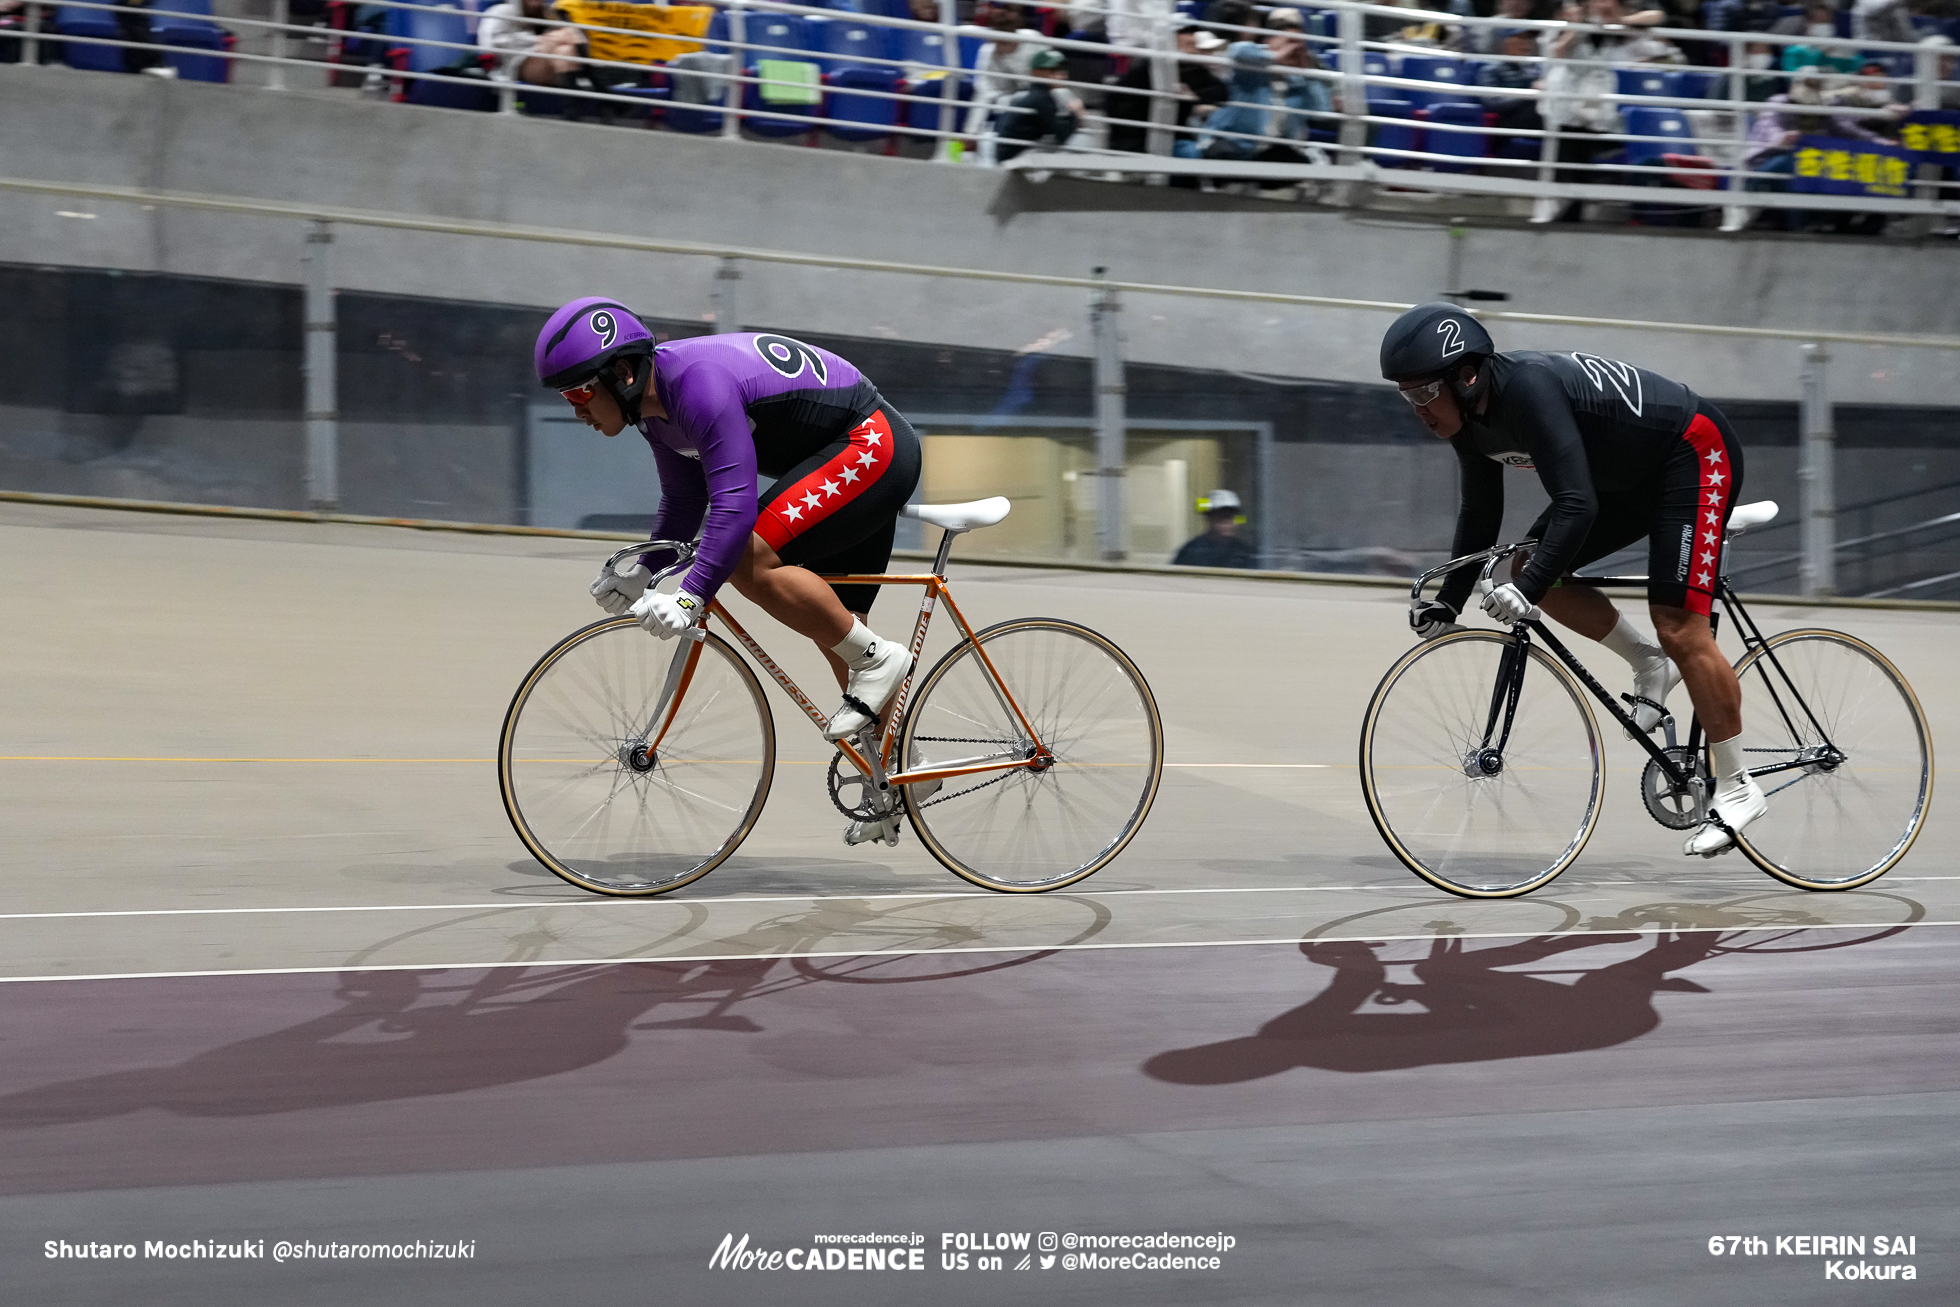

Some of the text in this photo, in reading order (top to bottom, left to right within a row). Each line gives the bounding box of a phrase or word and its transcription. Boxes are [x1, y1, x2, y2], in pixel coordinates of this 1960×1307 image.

[590, 310, 618, 350] 9
[624, 331, 648, 342] KEIRIN
[1437, 318, 1465, 358] 2
[752, 333, 827, 386] 9
[1571, 351, 1643, 417] 2
